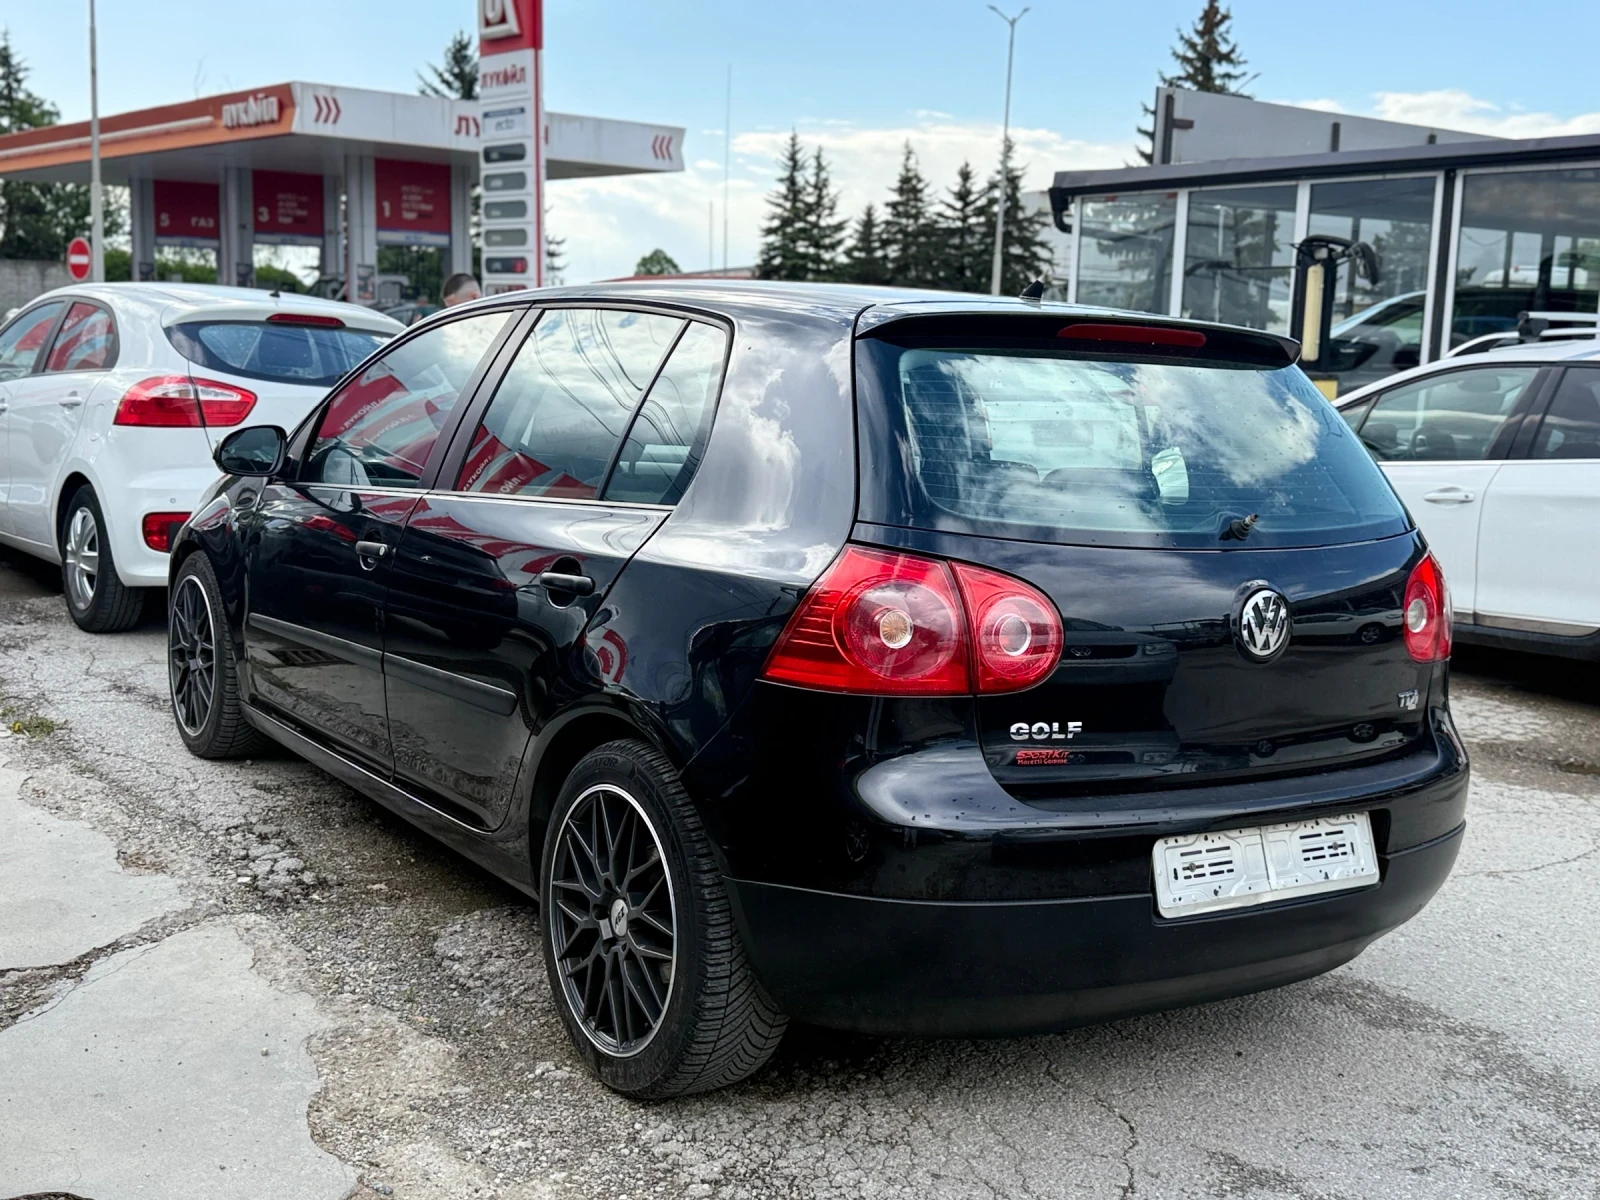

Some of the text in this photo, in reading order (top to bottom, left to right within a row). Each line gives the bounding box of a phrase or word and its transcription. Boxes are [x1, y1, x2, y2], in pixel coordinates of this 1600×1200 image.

[258, 207, 270, 222] 3
[382, 200, 391, 217] 1
[160, 212, 170, 227] 5
[191, 216, 215, 228] ГАЗ
[499, 477, 519, 494] ОЙЛ
[1010, 722, 1083, 740] GOLF
